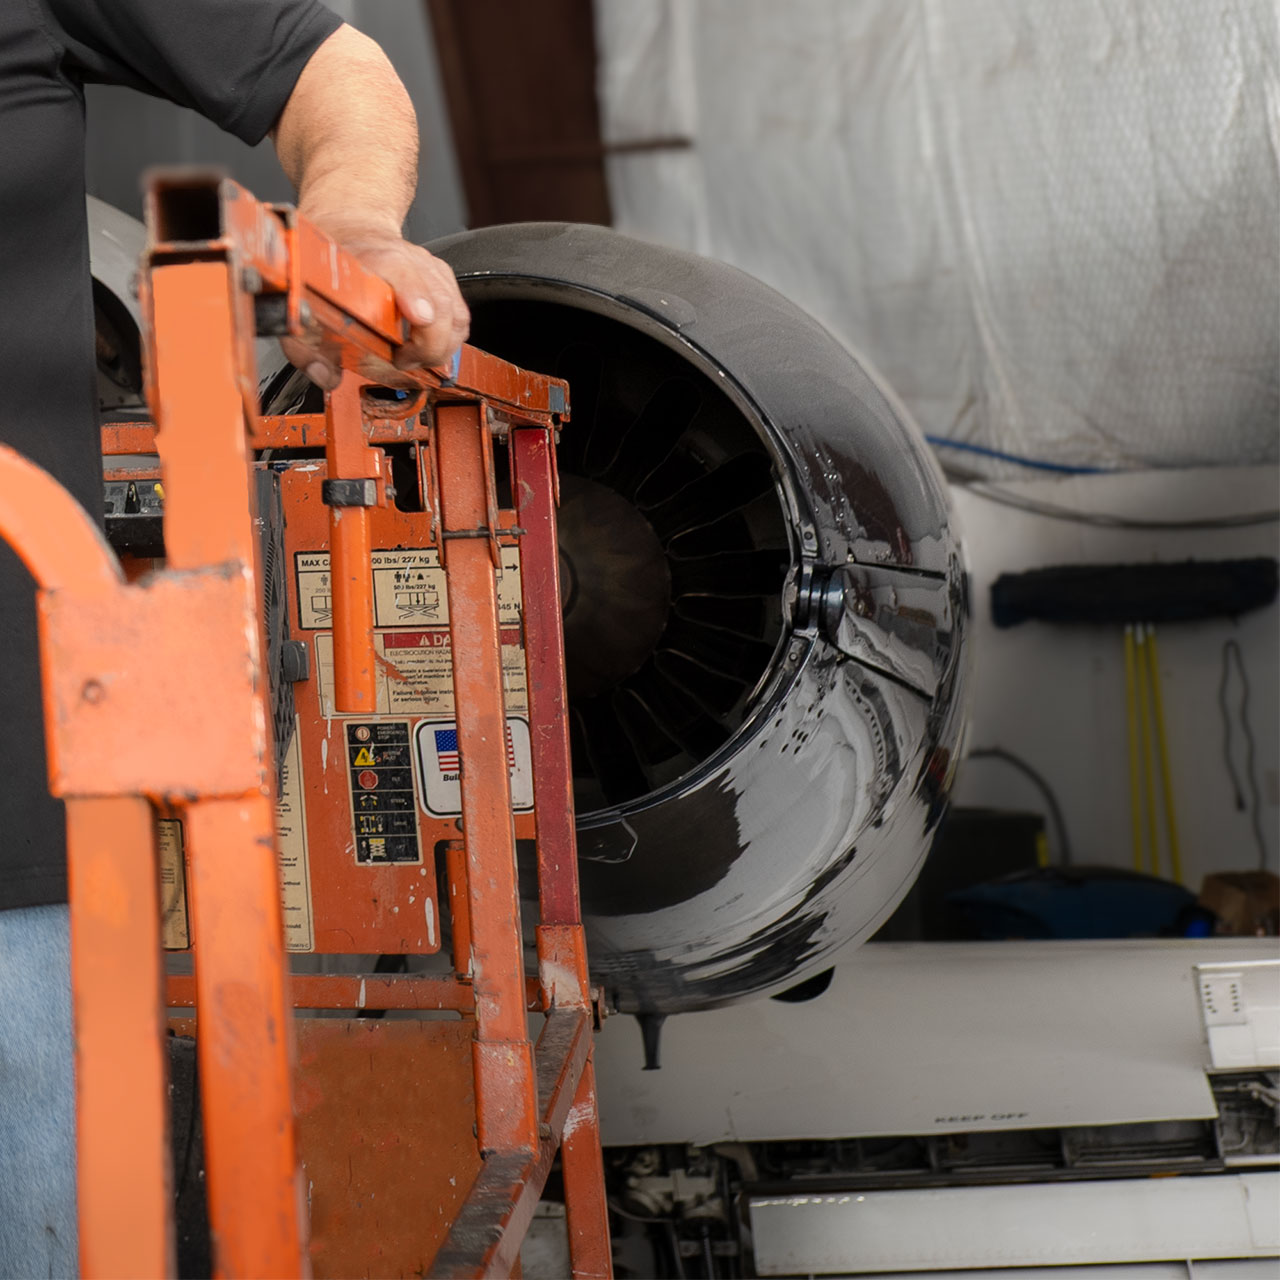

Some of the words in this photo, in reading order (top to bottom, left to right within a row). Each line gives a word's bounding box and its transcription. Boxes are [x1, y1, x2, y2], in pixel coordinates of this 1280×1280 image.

[372, 557, 383, 565] 00
[419, 556, 430, 564] kg
[934, 1115, 985, 1123] KEEP
[990, 1112, 1029, 1121] OFF
